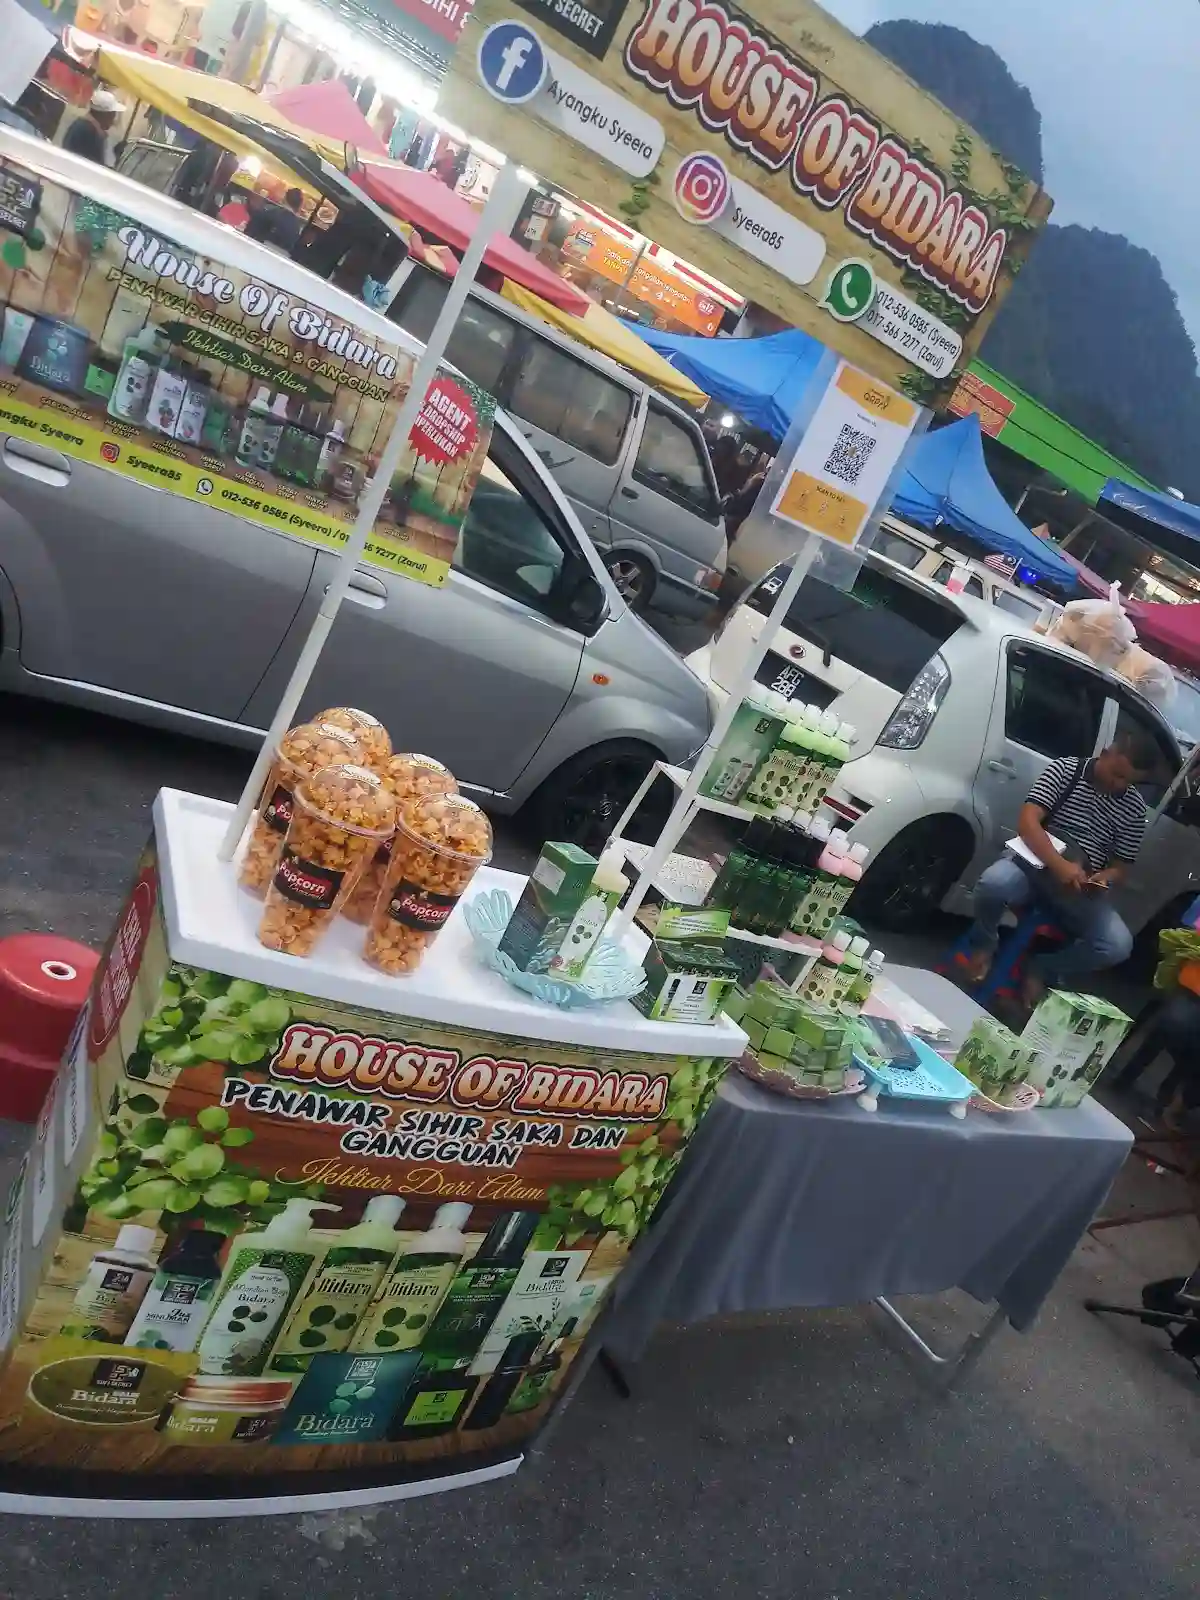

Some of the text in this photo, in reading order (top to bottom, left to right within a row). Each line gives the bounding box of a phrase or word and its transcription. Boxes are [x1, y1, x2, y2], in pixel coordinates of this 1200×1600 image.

[555, 0, 604, 38] SECRET
[547, 79, 653, 159] Ayangku Syeera
[632, 0, 1004, 306] HOUSE OF BIDARA
[731, 206, 785, 252] Syeera85
[117, 226, 398, 380] House Of Bidara
[106, 267, 389, 402] PENAWAR SIHIR SAKA & GANGGUAN
[866, 309, 945, 372] 017-566 7277 (Zarul)
[877, 291, 962, 359] 012-536 0585 (Syeera)
[182, 329, 309, 395] Ikhtiar Dari Alam
[0, 408, 84, 446] ngku Syeera
[422, 405, 466, 445] DROPSHIP
[428, 387, 472, 432] AGENT
[413, 414, 458, 458] IPERLUKAN
[126, 455, 183, 482] Syeera85
[221, 489, 262, 511] 012-536
[262, 504, 289, 520] 0585
[289, 513, 333, 538] (Syeera)
[376, 545, 428, 573] 7277 (Zarul)
[770, 676, 797, 698] 288
[279, 858, 326, 894] Popcorn
[402, 898, 450, 918] Popcorn
[272, 1025, 667, 1118] HOUSE OF BIDARA
[221, 1077, 627, 1149] PENAWAR SIHIR SAKA DAN
[340, 1128, 523, 1168] GANGGUAN
[274, 1156, 545, 1200] Ikhtiar Dari Alam
[238, 1293, 276, 1305] Bidara
[317, 1277, 372, 1296] Bidara
[389, 1281, 440, 1297] Bidara
[526, 1282, 563, 1292] Bidara
[71, 1388, 138, 1406] Bidara
[167, 1414, 216, 1433] Bidara
[294, 1412, 375, 1432] Bidara
